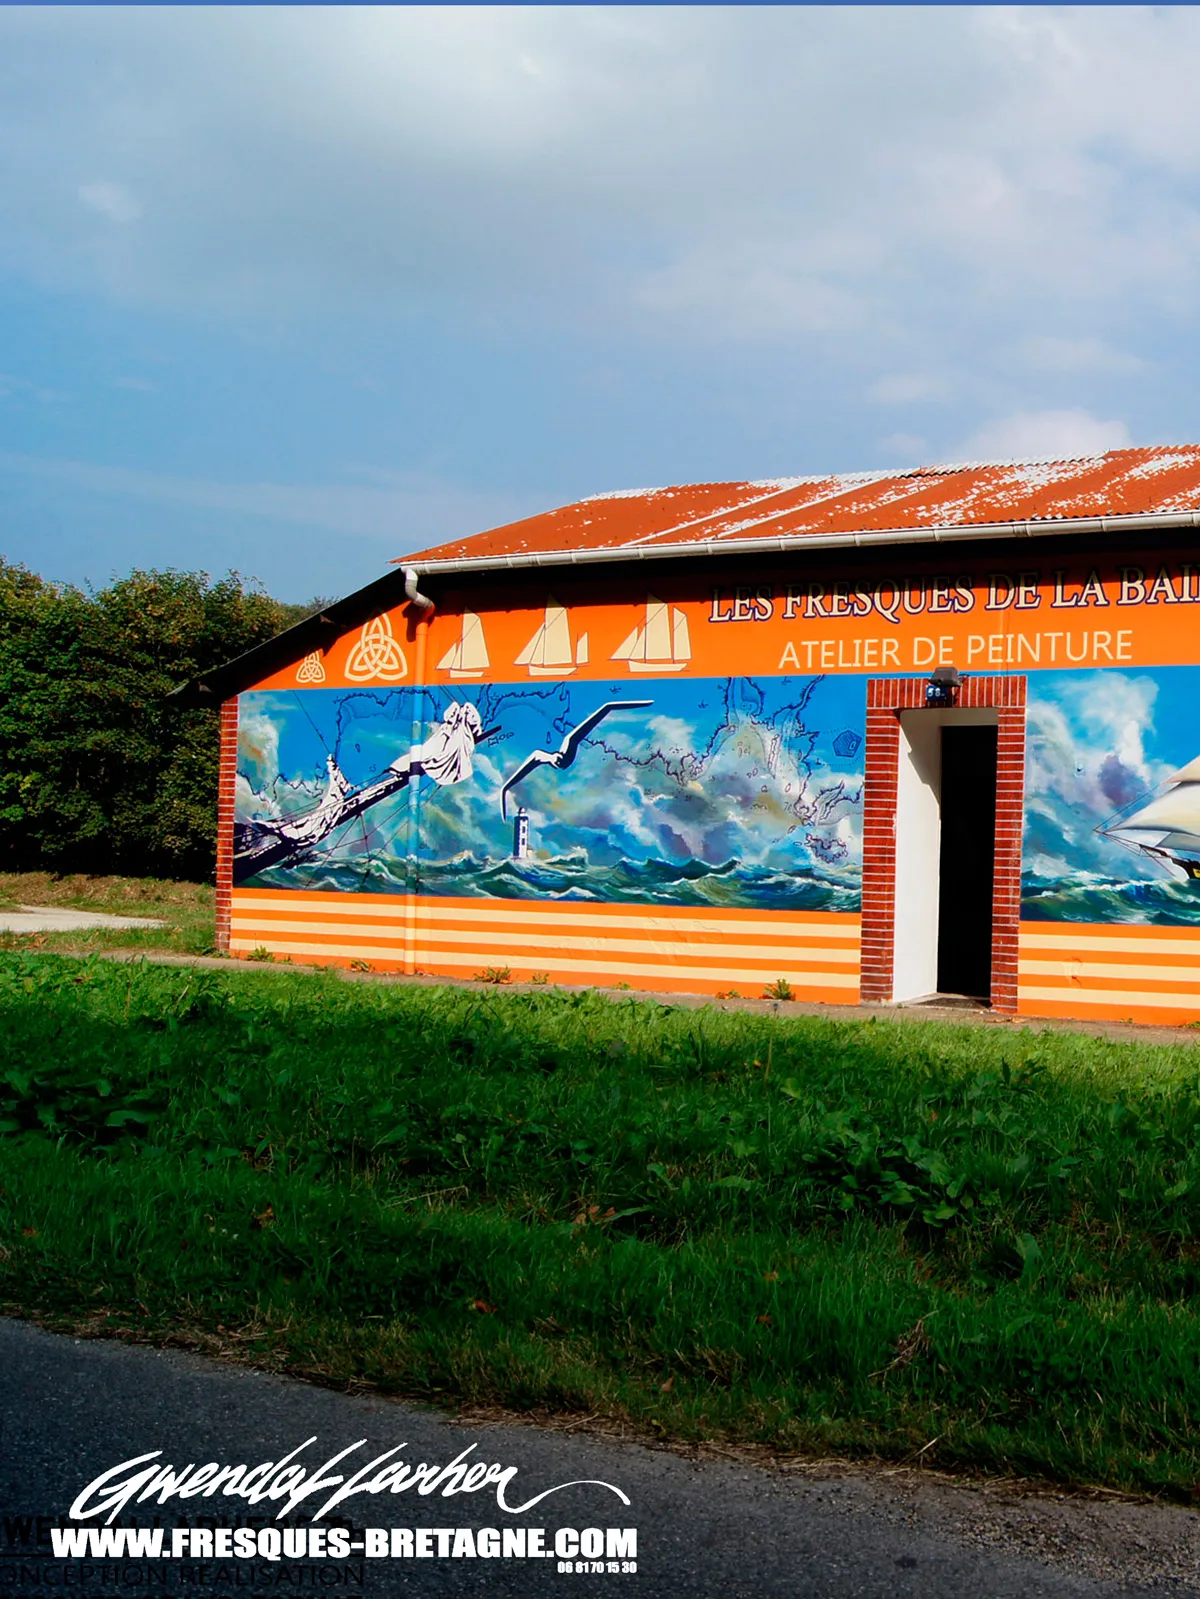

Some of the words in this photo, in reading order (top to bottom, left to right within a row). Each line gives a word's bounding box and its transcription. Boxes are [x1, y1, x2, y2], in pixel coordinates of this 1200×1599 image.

[709, 586, 774, 624] LES
[783, 578, 977, 623] FRESQUES
[985, 572, 1042, 611] DE
[1051, 568, 1111, 608] LA
[778, 637, 901, 669] ATELIER
[913, 636, 954, 665] DE
[967, 630, 1133, 664] PEINTURE
